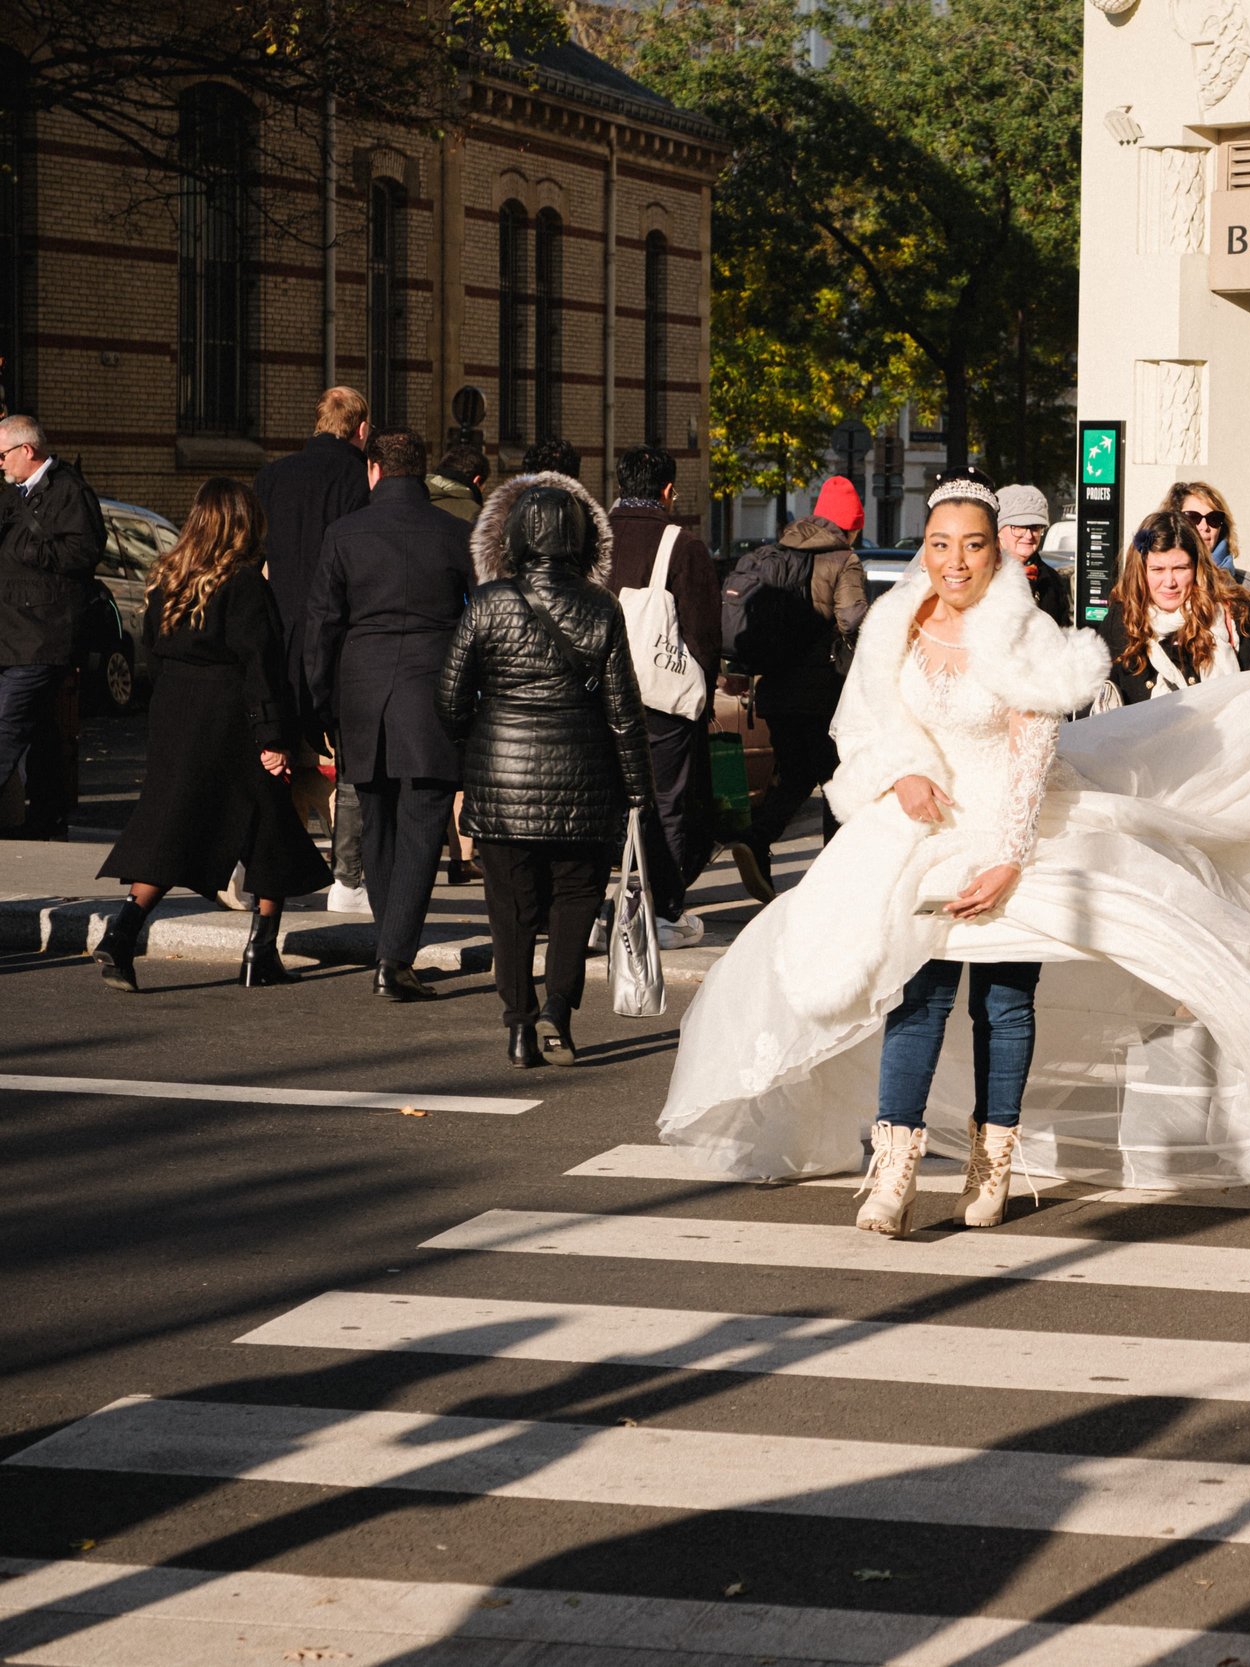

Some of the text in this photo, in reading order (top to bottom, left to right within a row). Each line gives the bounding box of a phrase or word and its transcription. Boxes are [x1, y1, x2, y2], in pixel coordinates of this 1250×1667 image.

[1086, 487, 1111, 501] PROJETS
[653, 633, 687, 659] Pars
[654, 652, 687, 675] Chill
